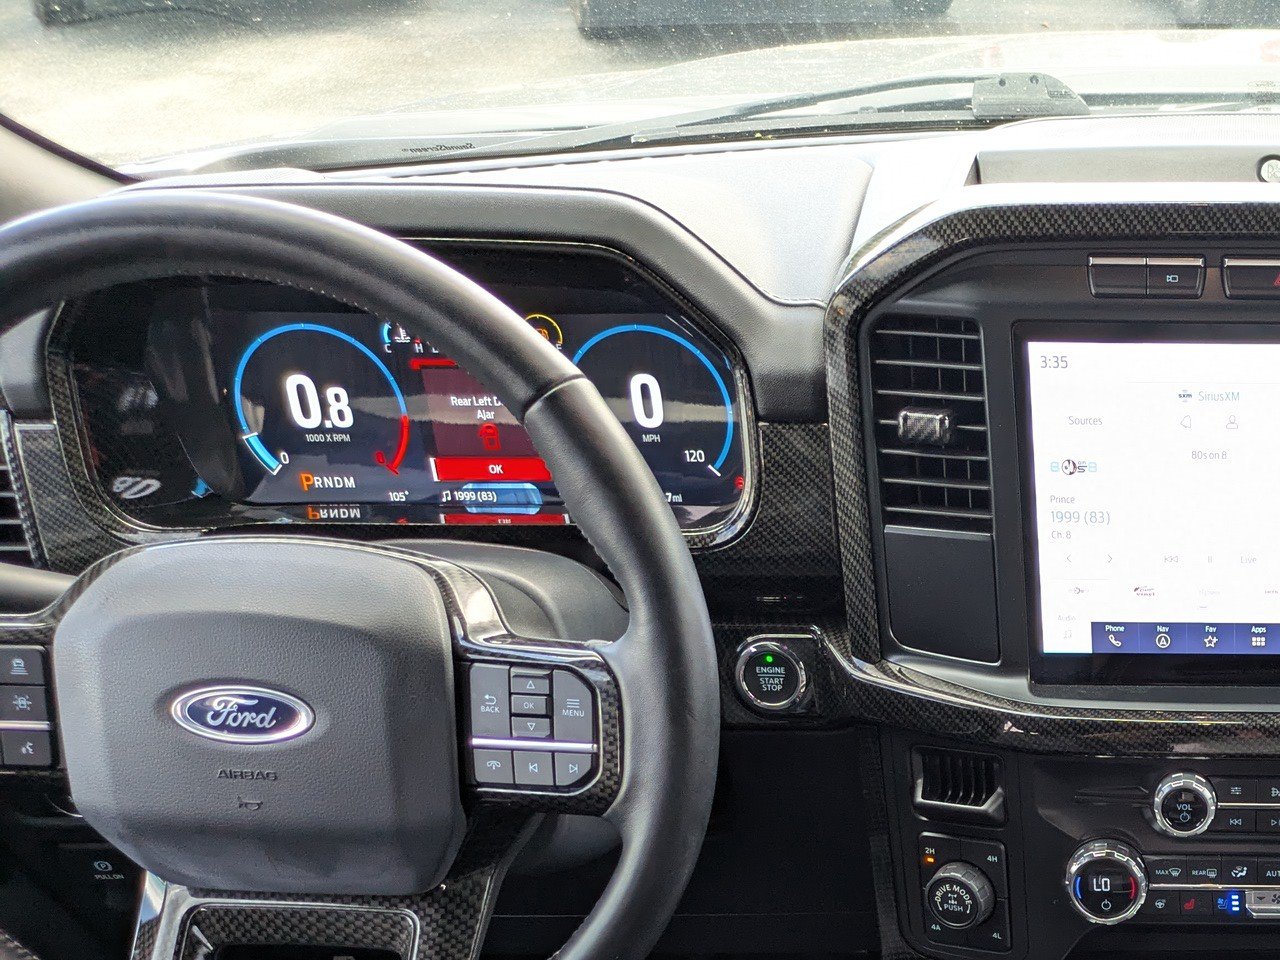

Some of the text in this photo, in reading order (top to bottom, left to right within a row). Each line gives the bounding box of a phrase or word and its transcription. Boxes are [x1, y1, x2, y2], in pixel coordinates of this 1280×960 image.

[415, 343, 423, 354] H
[1040, 355, 1068, 369] 3:35
[285, 373, 354, 429] 0.8
[450, 395, 471, 406] Rear
[472, 395, 492, 406] Left
[630, 373, 664, 429] 0
[1198, 390, 1240, 402] SiriusXM
[477, 409, 495, 421] Ajar
[1068, 415, 1103, 426] Sources
[305, 433, 351, 442] 1000 X RPM
[642, 434, 661, 443] MPH
[280, 451, 290, 465] 0
[684, 450, 705, 463] 120
[1191, 450, 1208, 460] 80s
[1208, 452, 1220, 460] on
[488, 464, 504, 475] OK
[454, 490, 497, 503] 1999 (83)
[1050, 494, 1076, 504] Prince
[1050, 510, 1111, 526] 1999 (83)
[1065, 530, 1072, 540] 8
[1240, 555, 1257, 564] Live
[1105, 625, 1125, 633] Phone
[1156, 625, 1170, 633] Nav
[1205, 625, 1217, 634] Fav
[1251, 626, 1267, 635] Apps
[755, 666, 786, 675] ENGINE
[759, 677, 785, 686] START
[762, 683, 783, 692] STOP
[480, 705, 500, 714] BACK
[523, 701, 535, 709] OK
[206, 696, 277, 729] Ford
[562, 708, 585, 718] MENU
[216, 767, 279, 782] AIRBAG
[1176, 803, 1193, 811] VOL
[924, 847, 936, 855] 2H
[986, 855, 998, 863] 4H
[1191, 869, 1207, 877] REAR
[934, 884, 973, 906] DRIVE MODE
[943, 903, 964, 912] PUSH
[930, 923, 942, 931] 4A
[992, 932, 1002, 940] 4L
